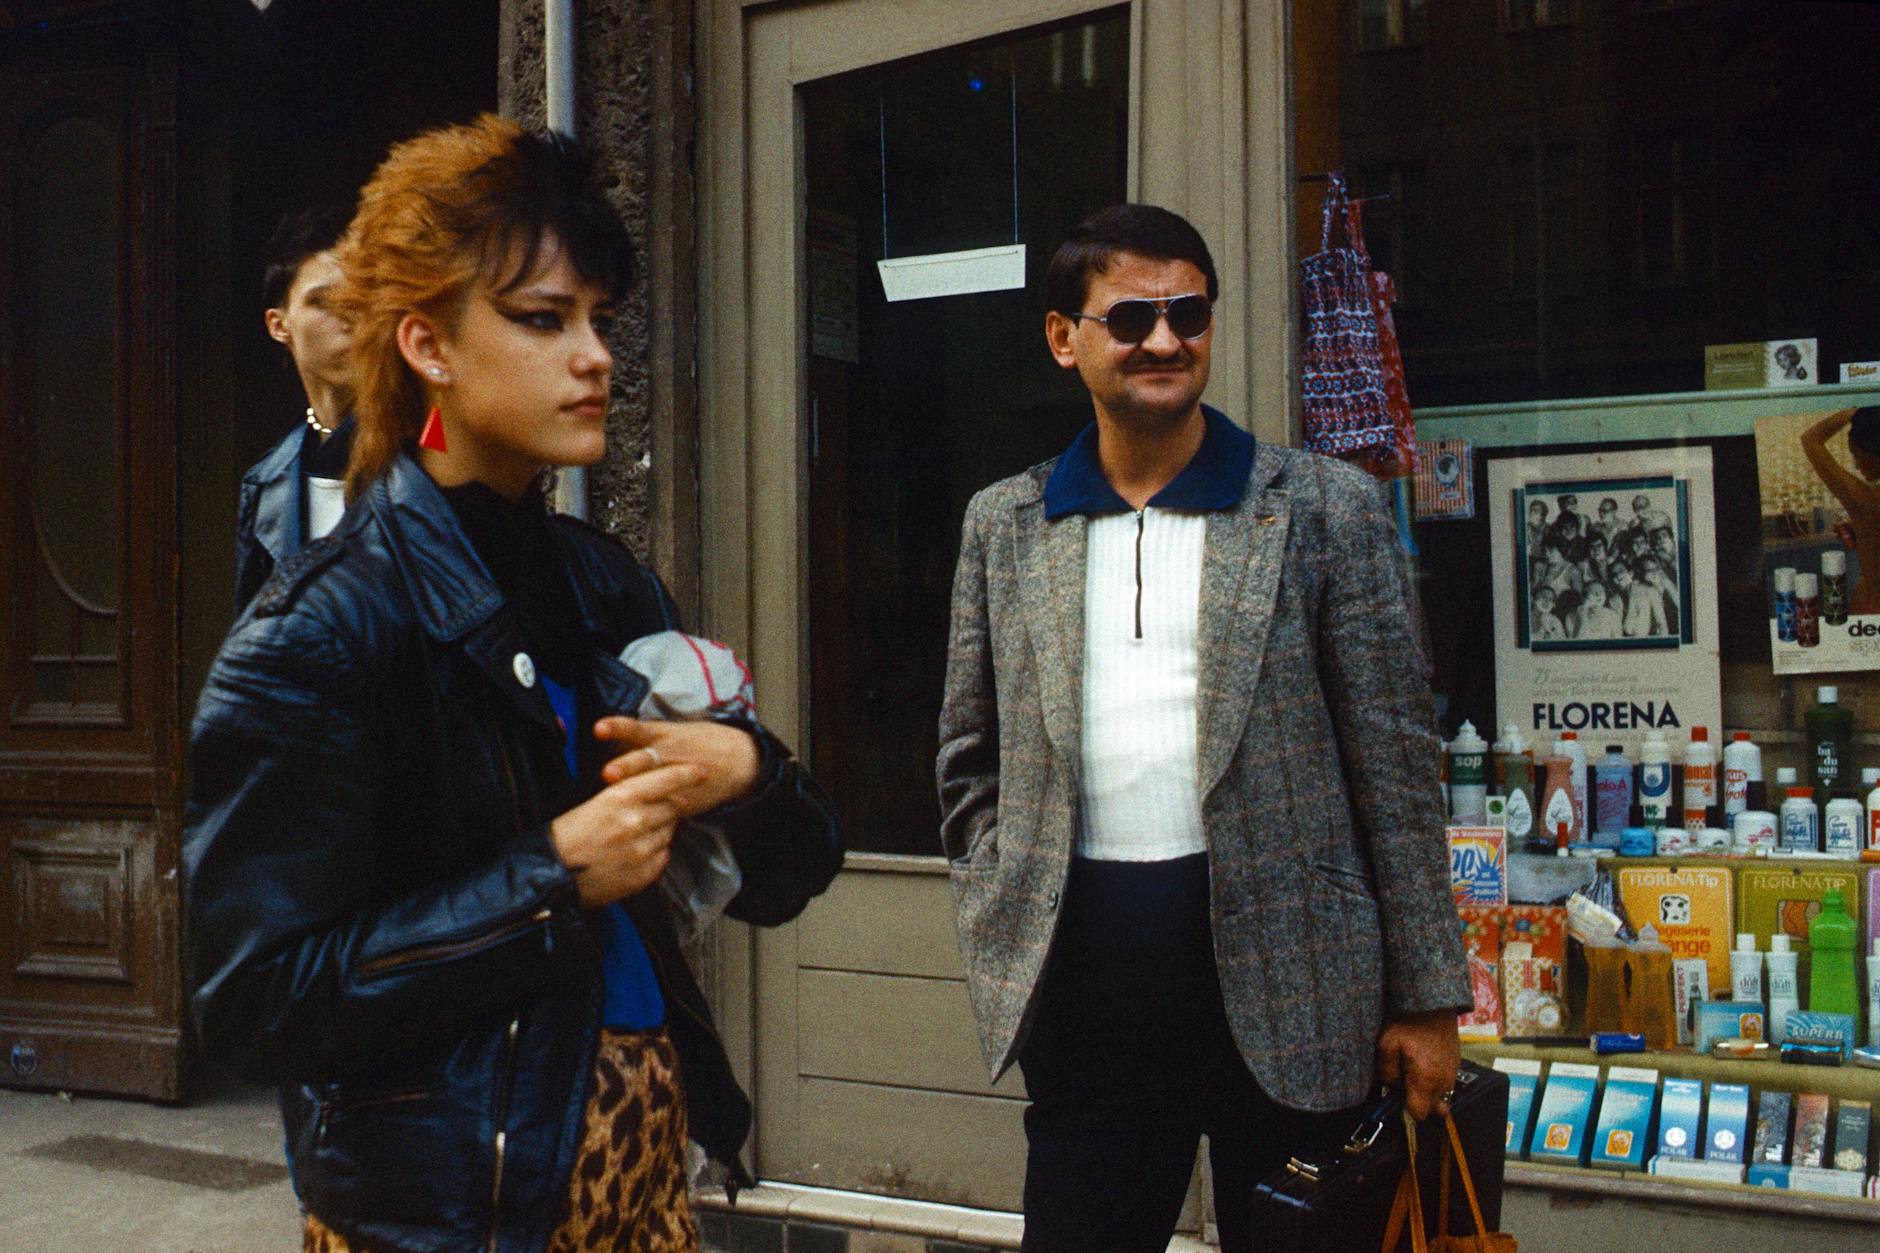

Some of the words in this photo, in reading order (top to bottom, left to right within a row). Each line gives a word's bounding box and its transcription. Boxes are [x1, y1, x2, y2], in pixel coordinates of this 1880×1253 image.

[1848, 619, 1880, 637] de
[1533, 701, 1681, 730] FLORENA
[1455, 755, 1482, 769] sop
[1662, 941, 1711, 957] ange
[1792, 1026, 1844, 1040] SUPERB
